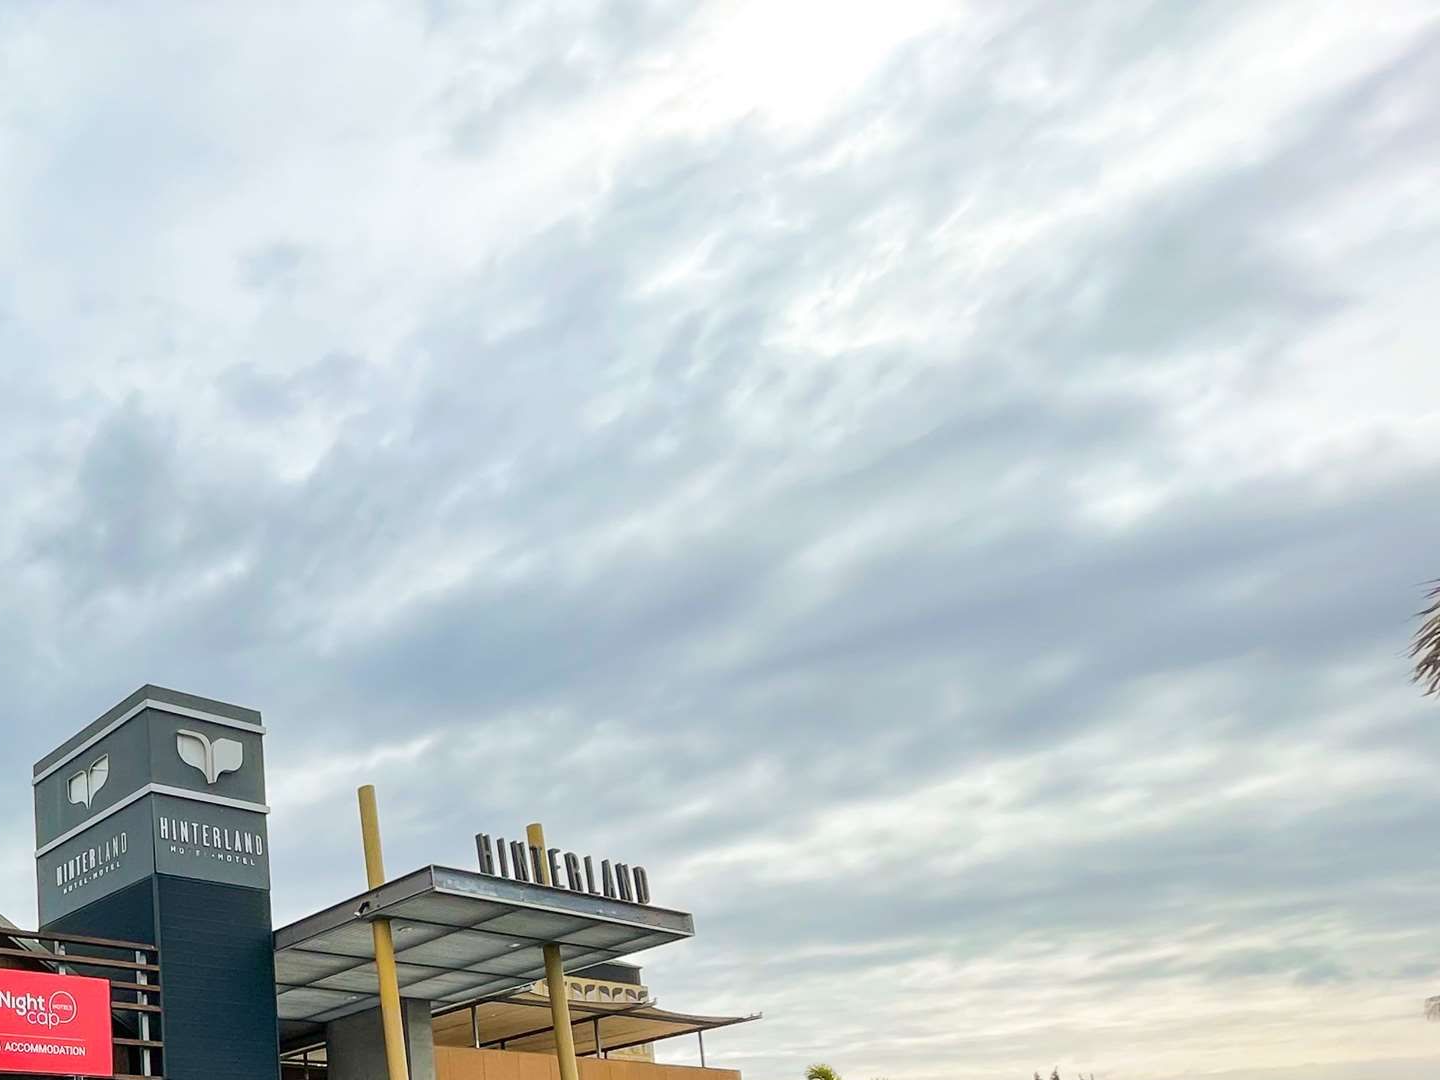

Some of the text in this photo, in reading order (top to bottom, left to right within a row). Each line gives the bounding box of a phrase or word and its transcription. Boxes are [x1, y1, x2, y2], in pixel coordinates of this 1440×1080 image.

[160, 817, 263, 855] HINTERLAND
[57, 832, 127, 886] HINTERLAND
[474, 832, 650, 904] HINTERLAND
[26, 1010, 60, 1030] cap
[4, 1042, 86, 1056] ACCOMMODATION
